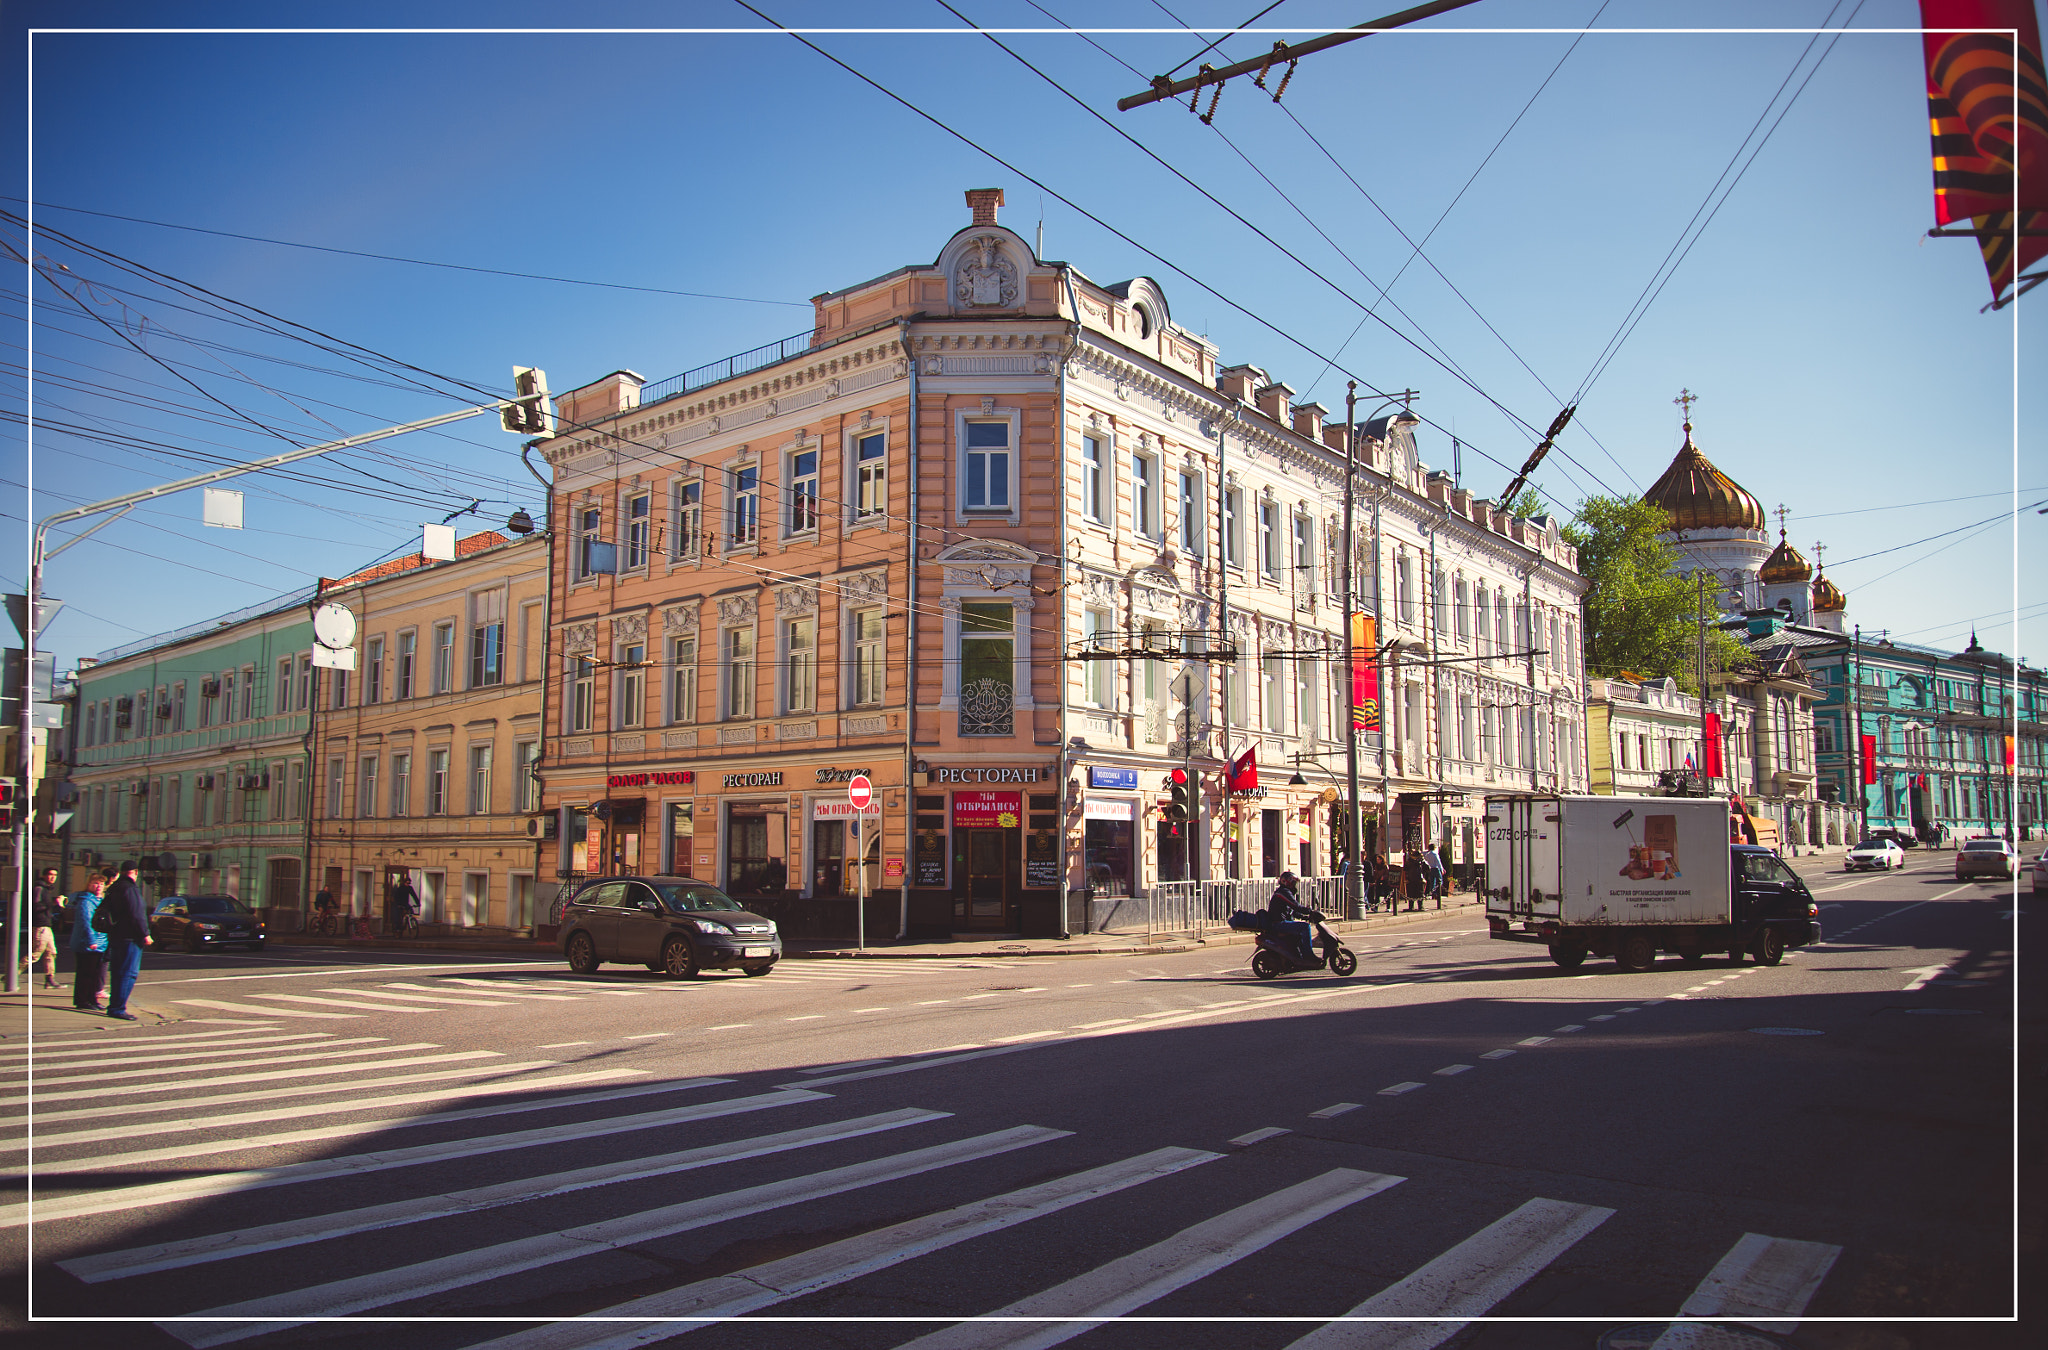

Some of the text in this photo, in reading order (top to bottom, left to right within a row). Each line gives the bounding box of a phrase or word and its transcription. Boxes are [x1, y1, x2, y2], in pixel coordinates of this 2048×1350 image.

[607, 771, 693, 788] САЛОН ЧАСОВ
[722, 772, 782, 788] РЕСТОРАН
[938, 768, 1037, 783] РЕСТОРАН
[1128, 772, 1133, 783] 9
[980, 792, 996, 801] МЫ
[816, 802, 880, 816] МЫ ОТКРЫИСЬ
[956, 802, 1020, 811] ОТКРЫЛИСЬ!
